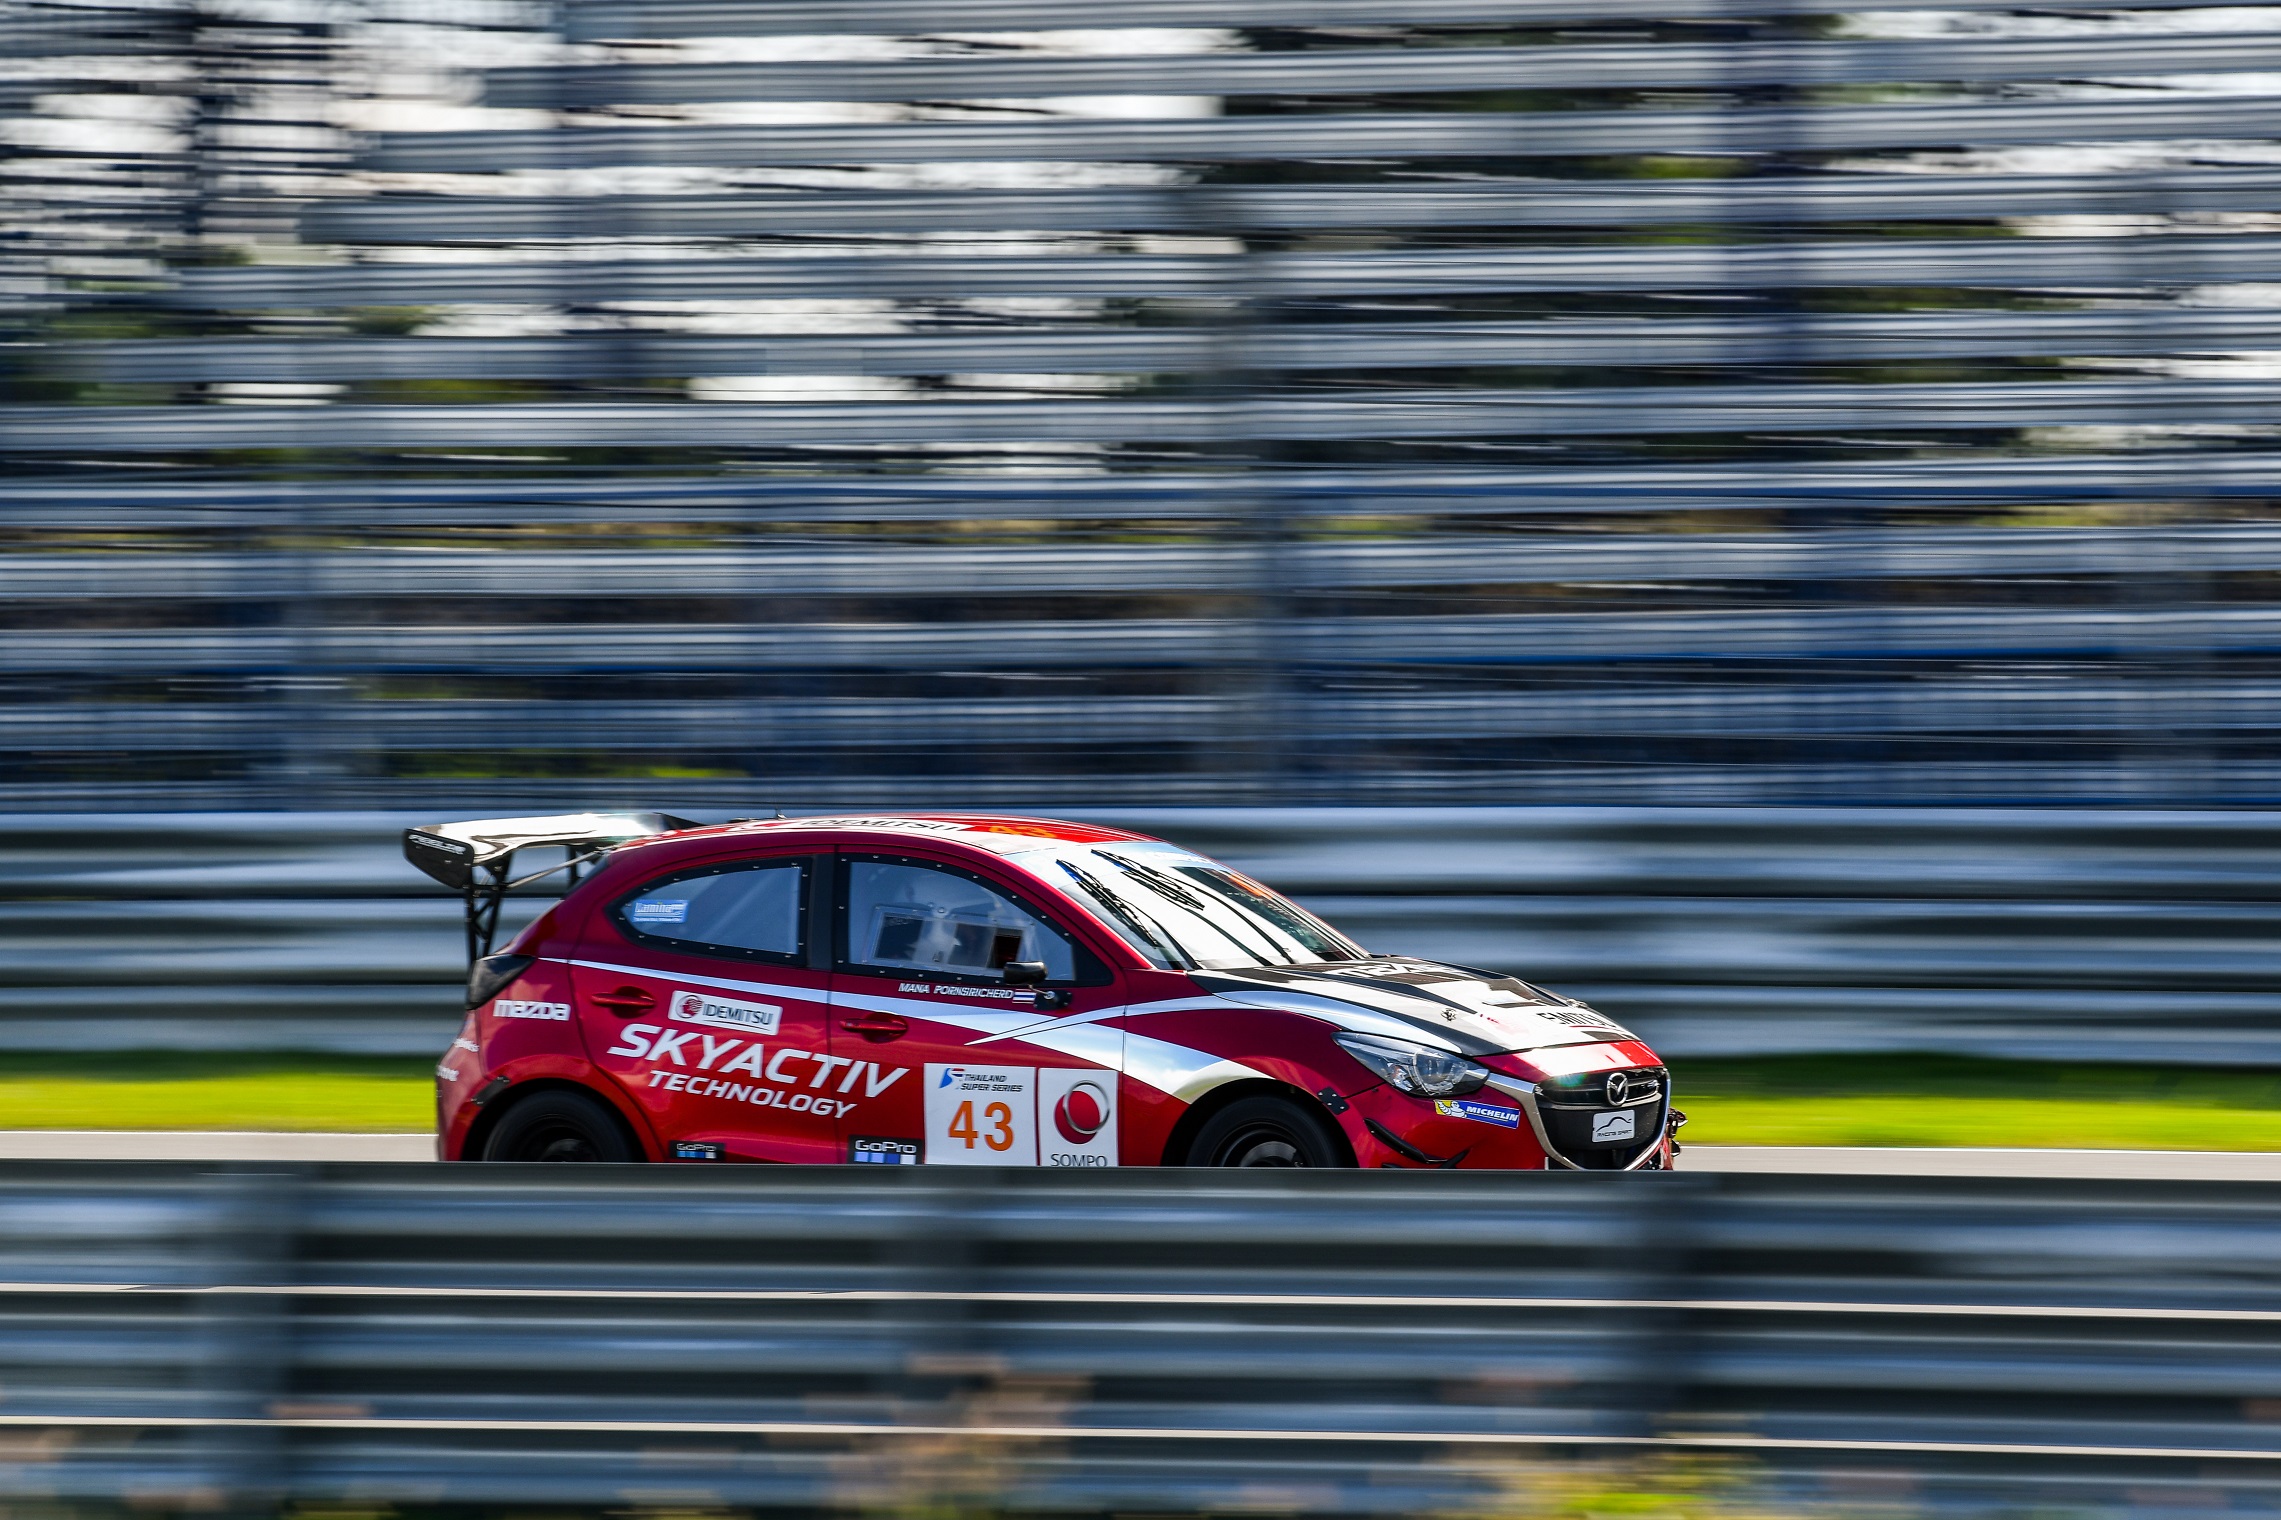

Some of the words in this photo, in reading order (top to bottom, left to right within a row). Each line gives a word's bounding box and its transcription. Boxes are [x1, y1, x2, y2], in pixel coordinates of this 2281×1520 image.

[898, 982, 930, 994] MANA
[493, 999, 571, 1021] mazda
[702, 1003, 774, 1026] IDEMITSU
[607, 1023, 910, 1098] SKYACTIV
[964, 1073, 1008, 1083] THAILAND
[648, 1069, 857, 1119] TECHNOLOGY
[960, 1082, 990, 1091] SUPER
[991, 1083, 1024, 1093] SERIES
[1466, 1105, 1519, 1122] MICHELIN
[948, 1100, 1015, 1151] 43
[676, 1143, 717, 1152] GoPro
[854, 1139, 917, 1154] GoPro
[1050, 1153, 1108, 1167] SOMPO
